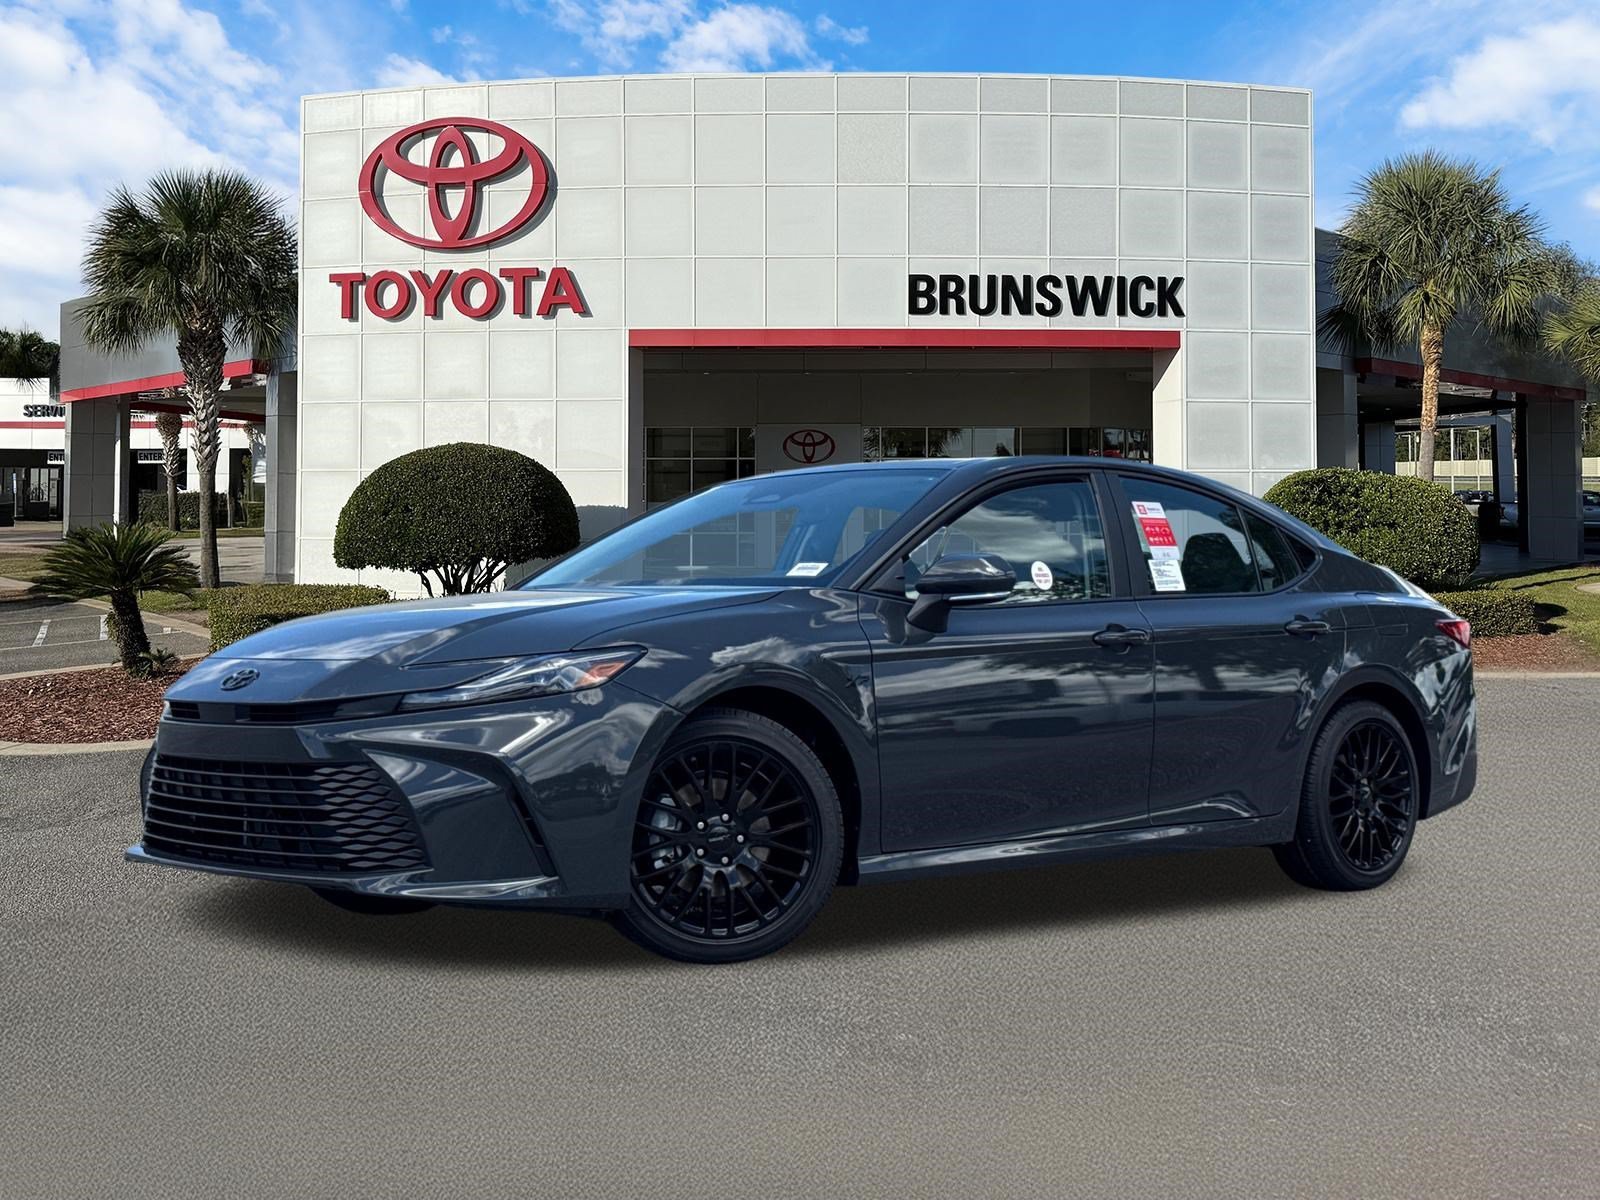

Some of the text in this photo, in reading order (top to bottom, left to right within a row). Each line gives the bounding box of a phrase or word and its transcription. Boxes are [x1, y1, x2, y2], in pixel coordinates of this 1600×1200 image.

[329, 267, 587, 320] TOYOTA
[908, 274, 1186, 317] BRUNSWICK
[23, 404, 65, 417] SERVI
[49, 452, 65, 461] ENT
